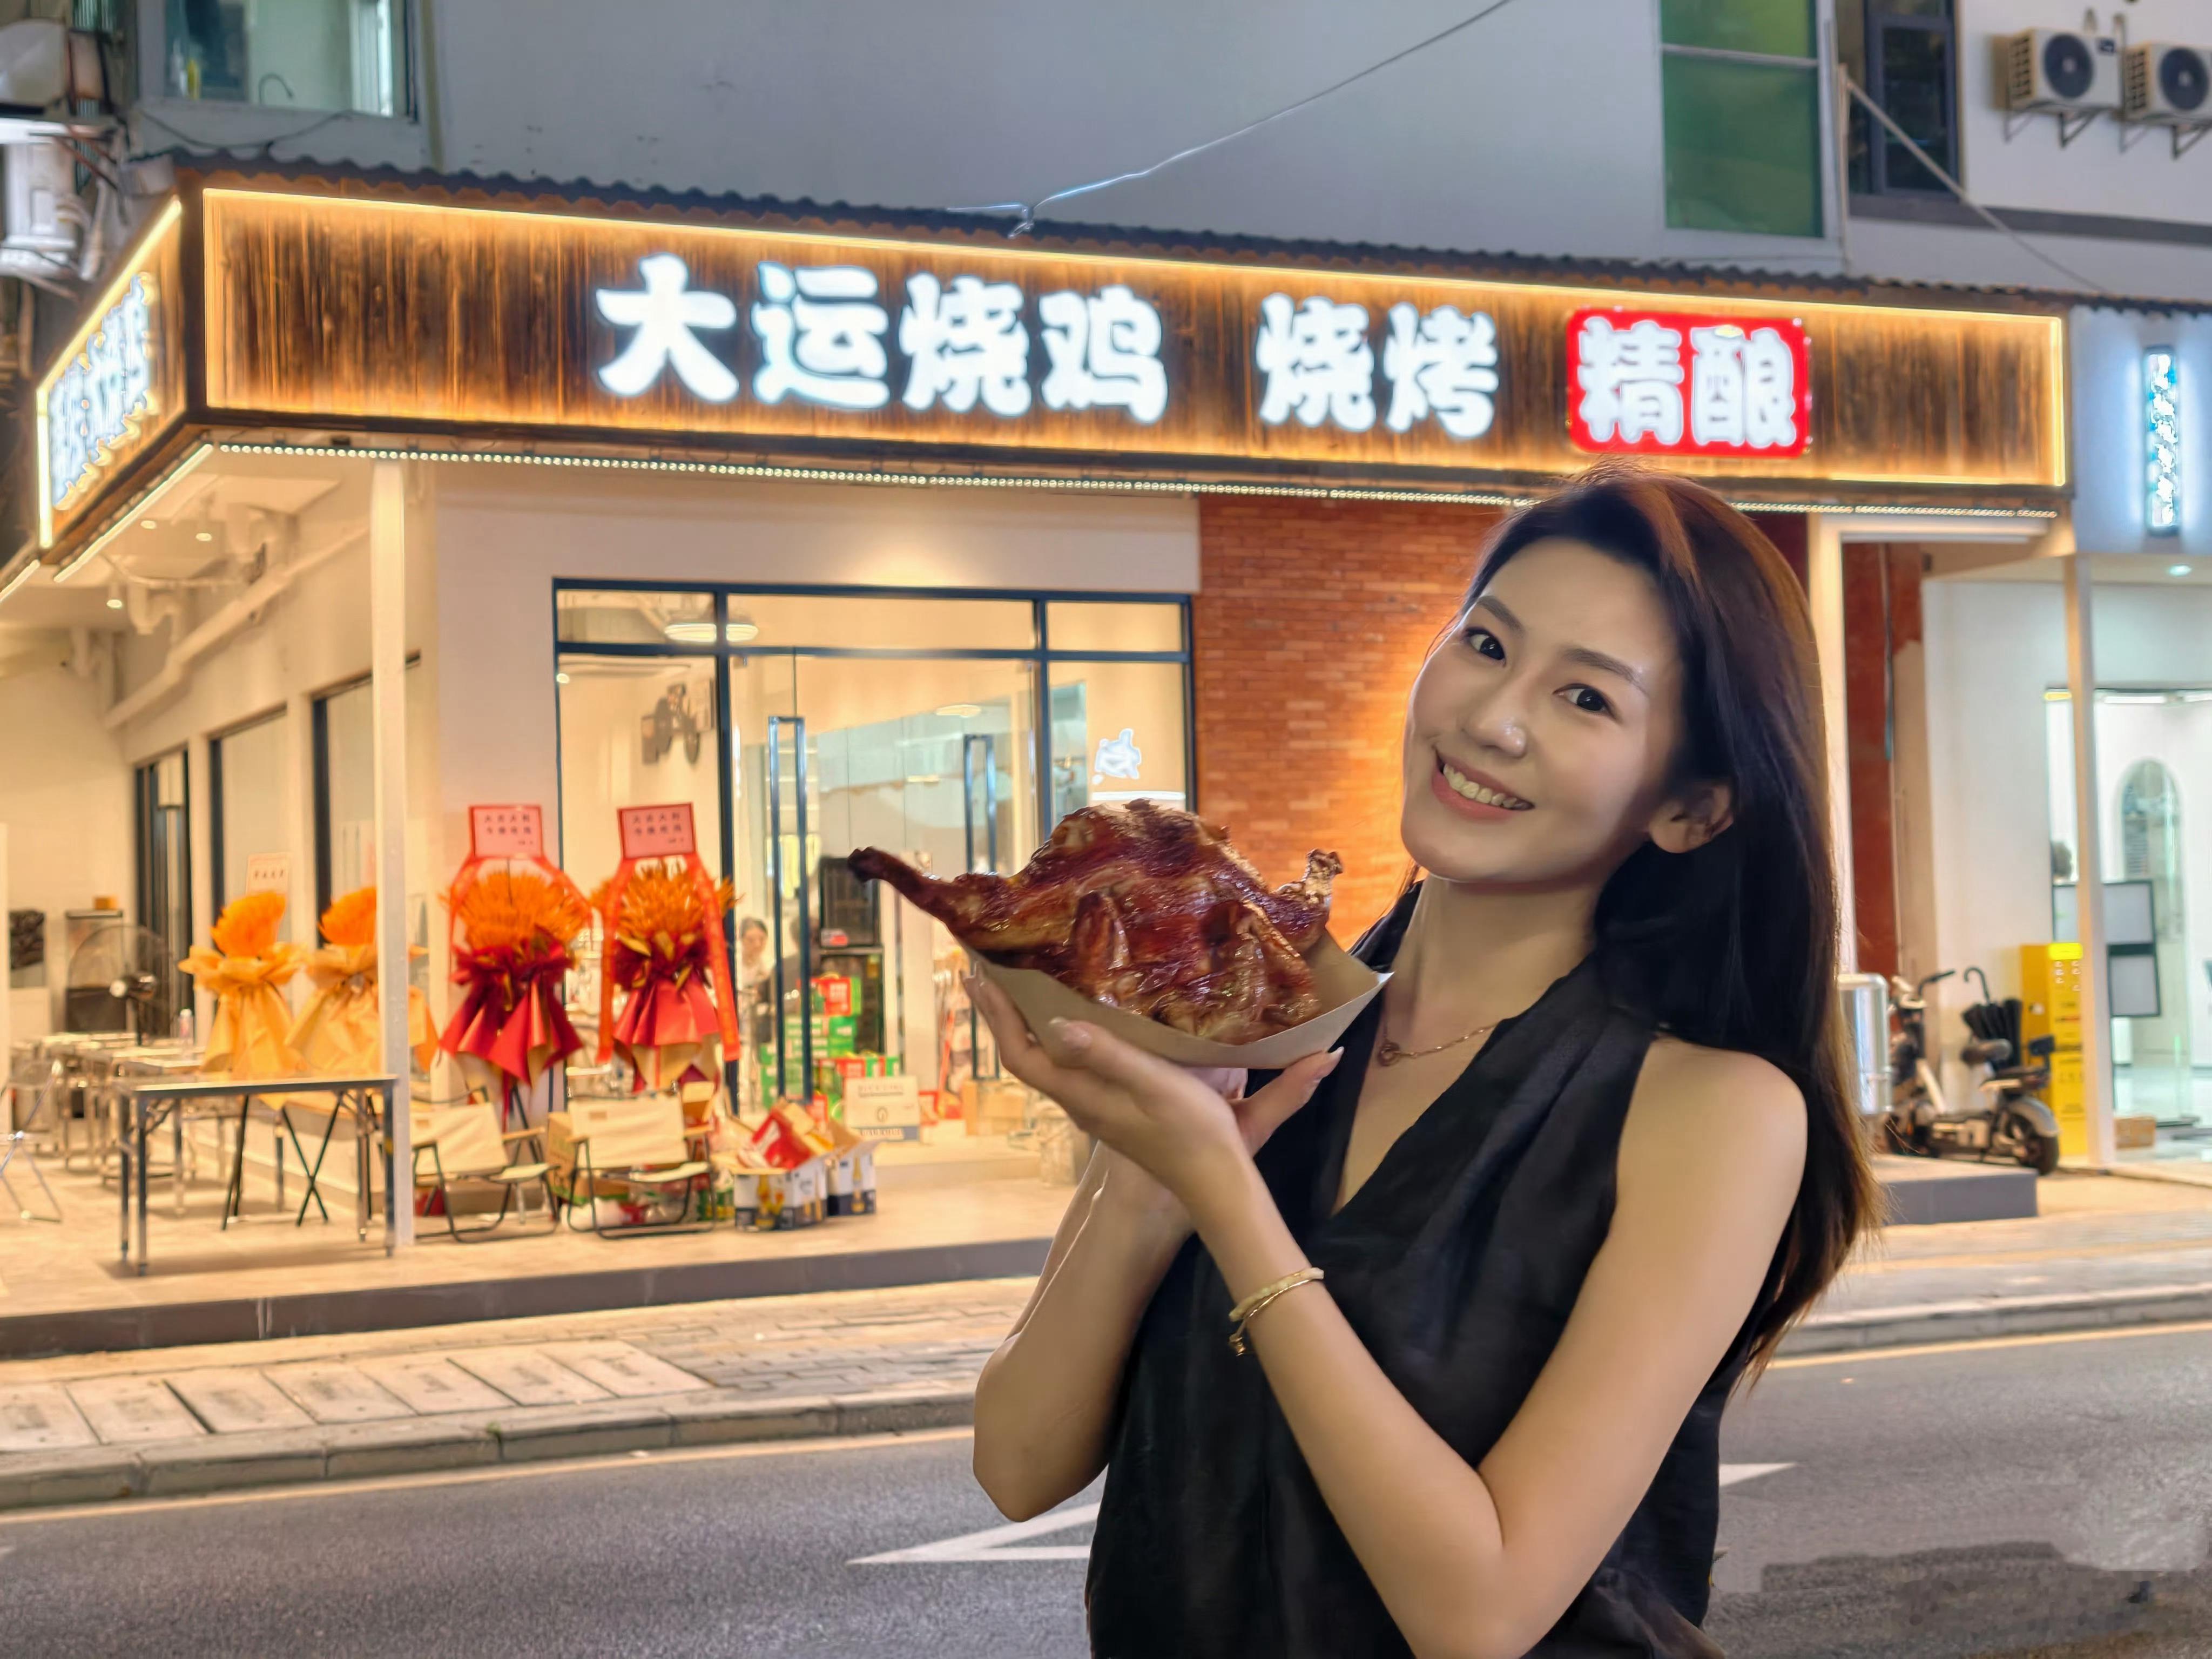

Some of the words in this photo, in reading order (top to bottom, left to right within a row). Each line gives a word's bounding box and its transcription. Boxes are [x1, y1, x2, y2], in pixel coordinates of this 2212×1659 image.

[596, 254, 1167, 423] 大运烧鸡
[1257, 294, 1498, 438] 烧烤
[1578, 316, 1797, 448] 精酿
